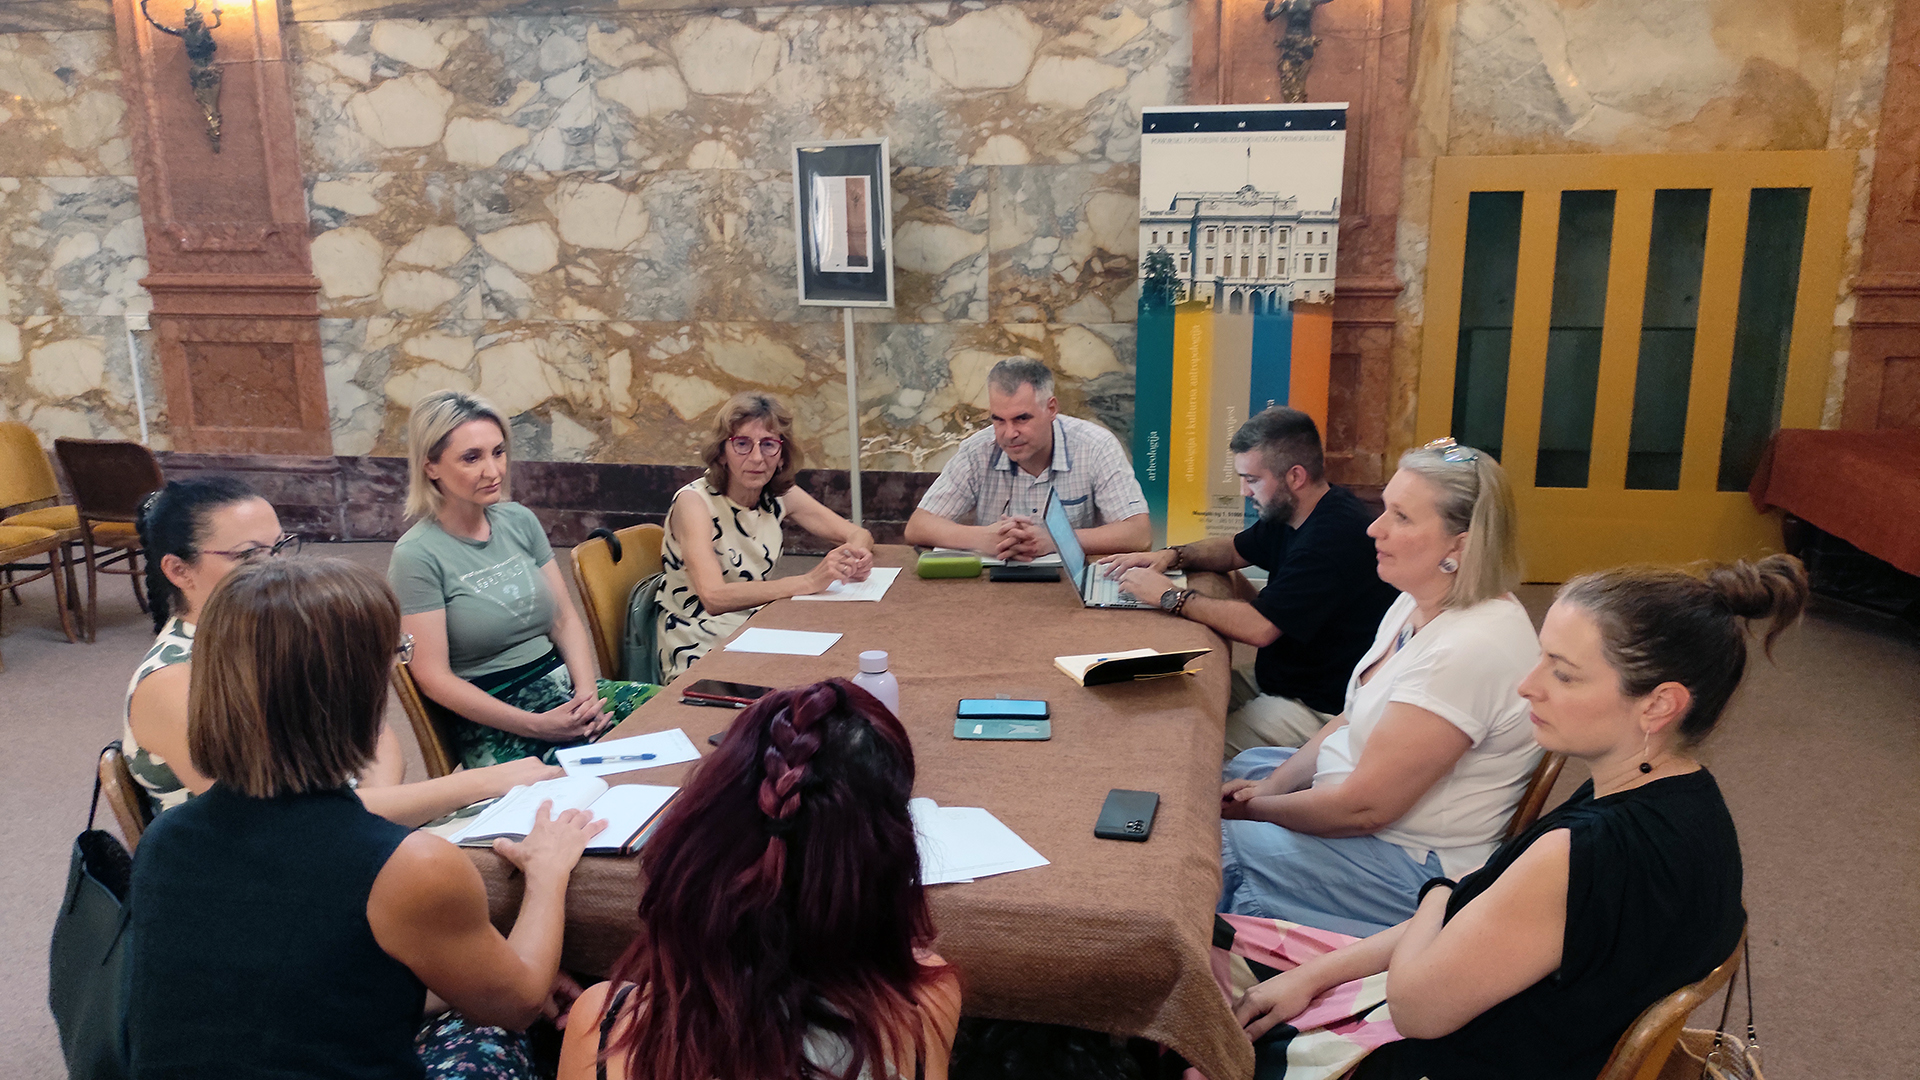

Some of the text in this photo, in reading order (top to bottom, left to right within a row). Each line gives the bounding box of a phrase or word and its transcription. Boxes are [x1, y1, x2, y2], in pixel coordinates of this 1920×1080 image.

[1188, 324, 1202, 387] antropologija
[1186, 388, 1198, 430] kulturna
[1146, 430, 1160, 481] arheologija
[1185, 436, 1198, 482] etnologija
